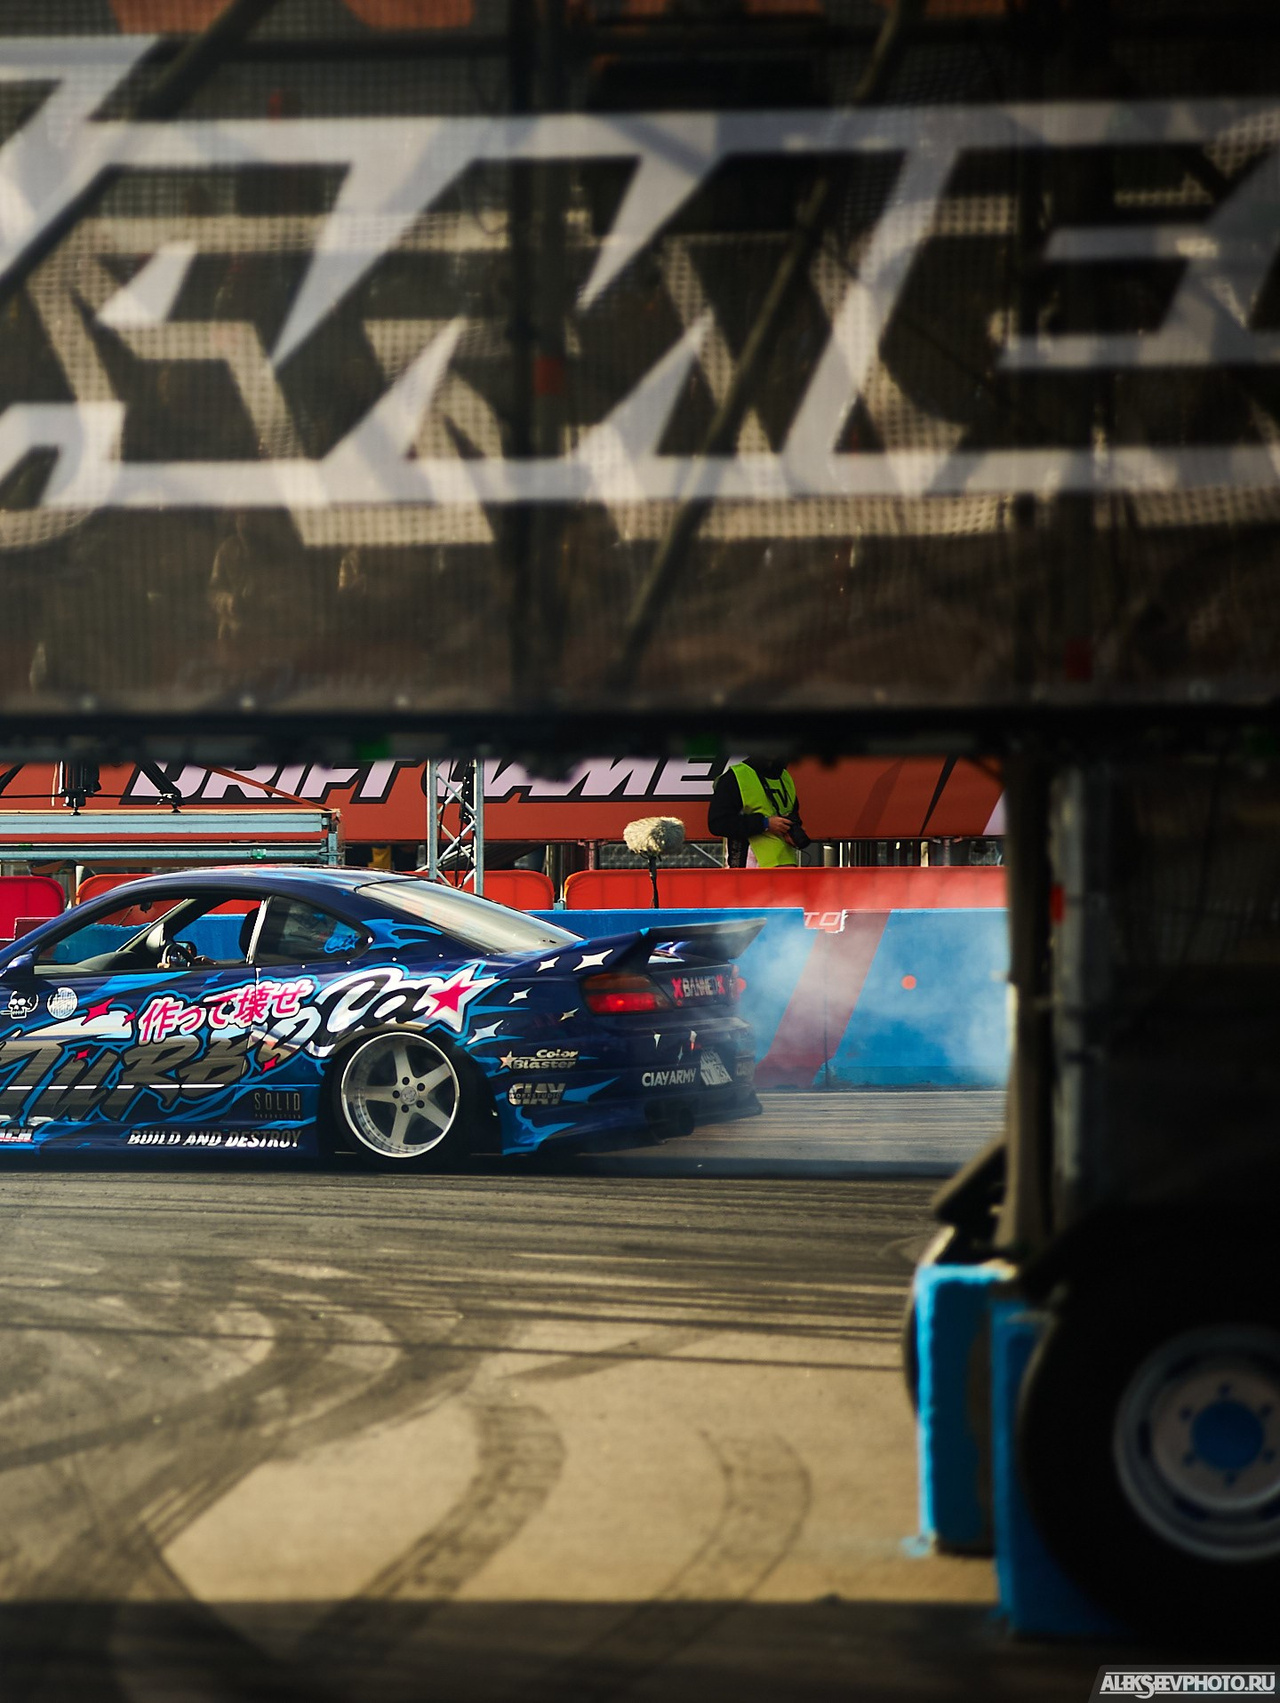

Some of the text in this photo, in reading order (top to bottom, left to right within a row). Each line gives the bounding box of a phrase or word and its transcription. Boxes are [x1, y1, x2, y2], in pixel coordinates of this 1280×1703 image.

[423, 757, 750, 797] GAME
[536, 1048, 579, 1059] Color
[513, 1059, 576, 1070] Blaster
[254, 1092, 301, 1111] SOLID
[127, 1129, 302, 1148] BUILD AND DESTROY
